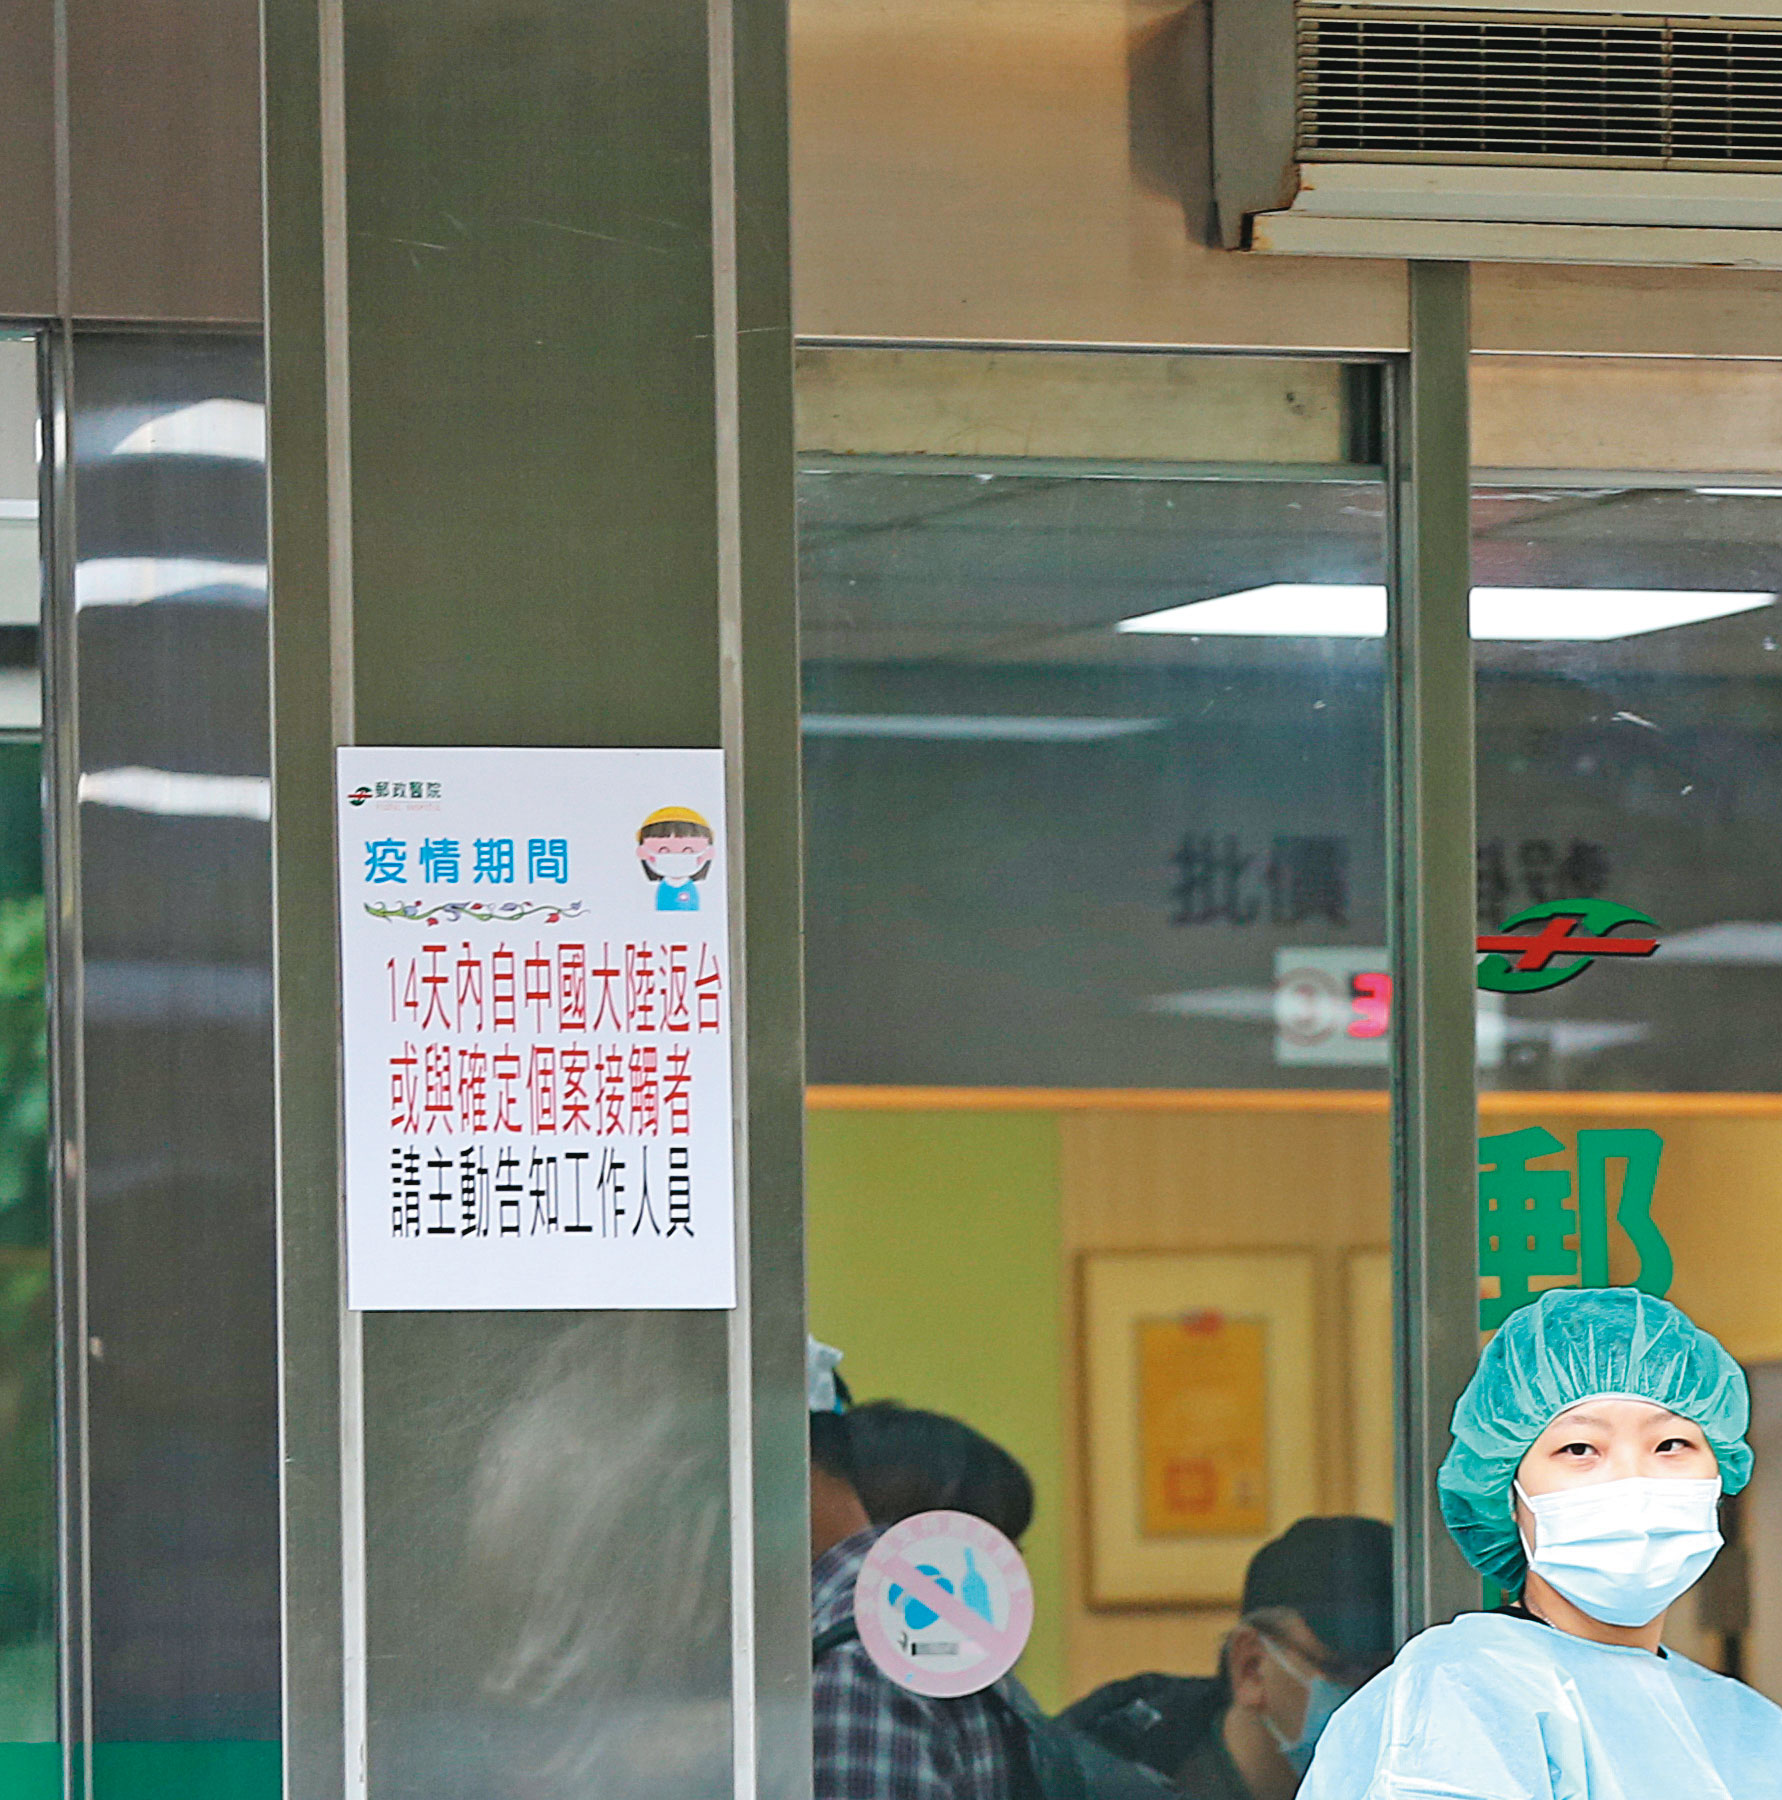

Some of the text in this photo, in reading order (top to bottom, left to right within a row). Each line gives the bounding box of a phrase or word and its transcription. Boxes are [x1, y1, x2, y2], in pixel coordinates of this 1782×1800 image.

[364, 838, 569, 885] 疫情期間
[387, 941, 724, 1035] 14天內自中國大陸返台
[389, 1042, 694, 1137] 或與確定個案接觸者
[390, 1146, 696, 1239] 請主動告知工作人員
